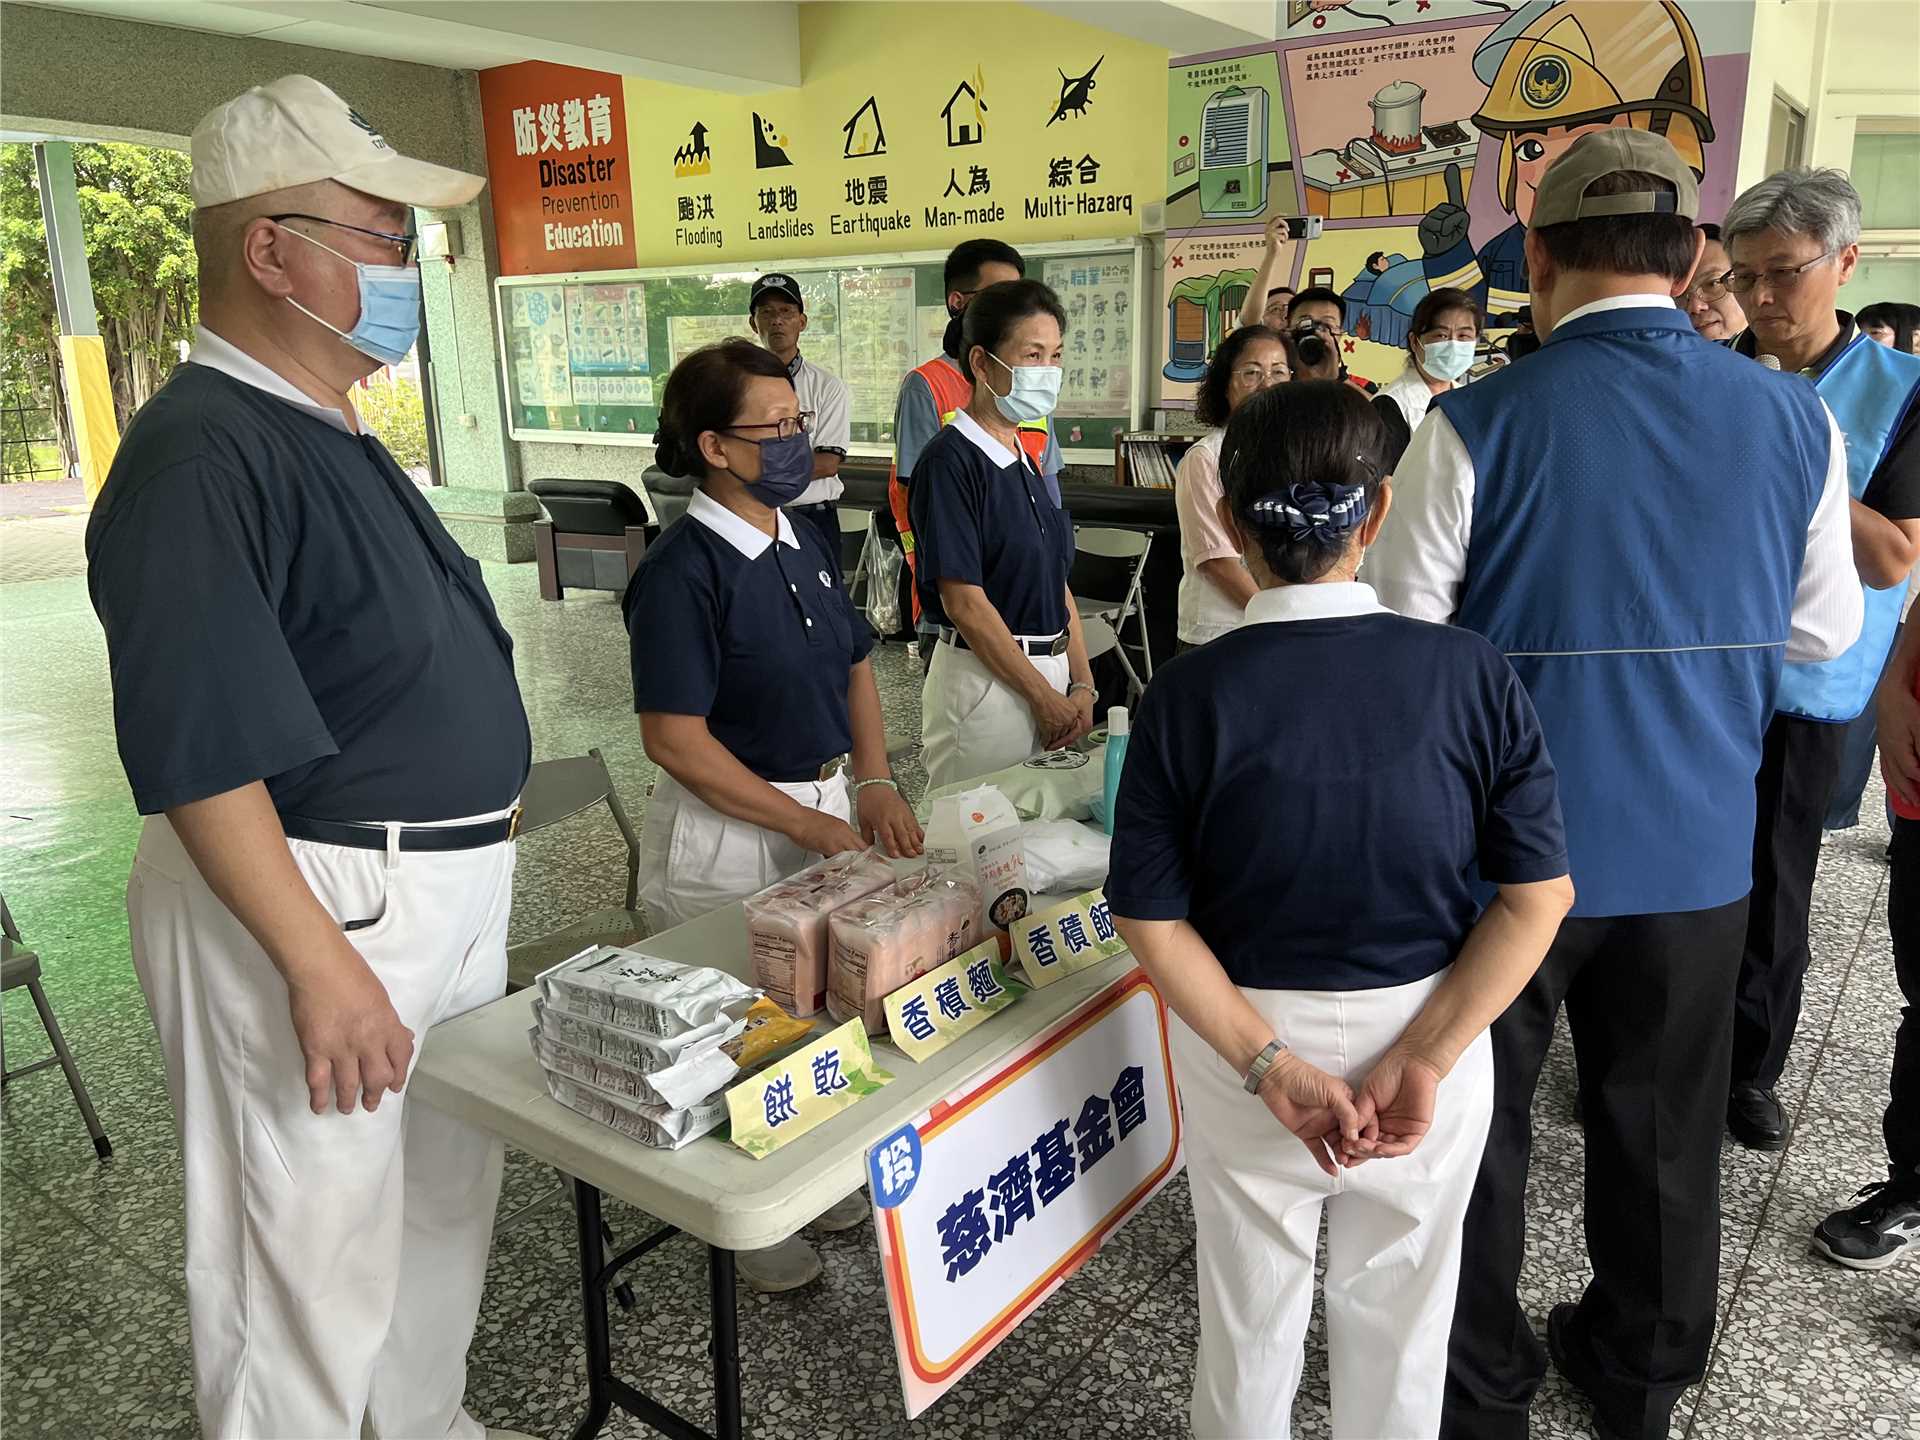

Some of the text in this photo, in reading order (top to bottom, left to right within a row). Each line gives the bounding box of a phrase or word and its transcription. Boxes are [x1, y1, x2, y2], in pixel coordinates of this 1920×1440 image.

[511, 94, 612, 157] 防災教育
[539, 156, 616, 188] Disaster
[943, 165, 991, 199] 人為
[1048, 154, 1101, 189] 綜合
[541, 191, 620, 217] Prevention
[758, 185, 797, 215] 坡地
[845, 175, 888, 206] 地震
[748, 218, 814, 240] Landslides
[830, 210, 912, 238] Earthquake
[924, 203, 1005, 229] Man-made
[543, 218, 624, 251] Education
[675, 226, 723, 248] Flooding
[1028, 901, 1115, 968] 香積飯
[900, 958, 1002, 1041] 香積麵
[763, 1049, 849, 1128] 餅乾
[878, 1135, 916, 1197] 投
[936, 1065, 1148, 1284] 慈濟基金會
